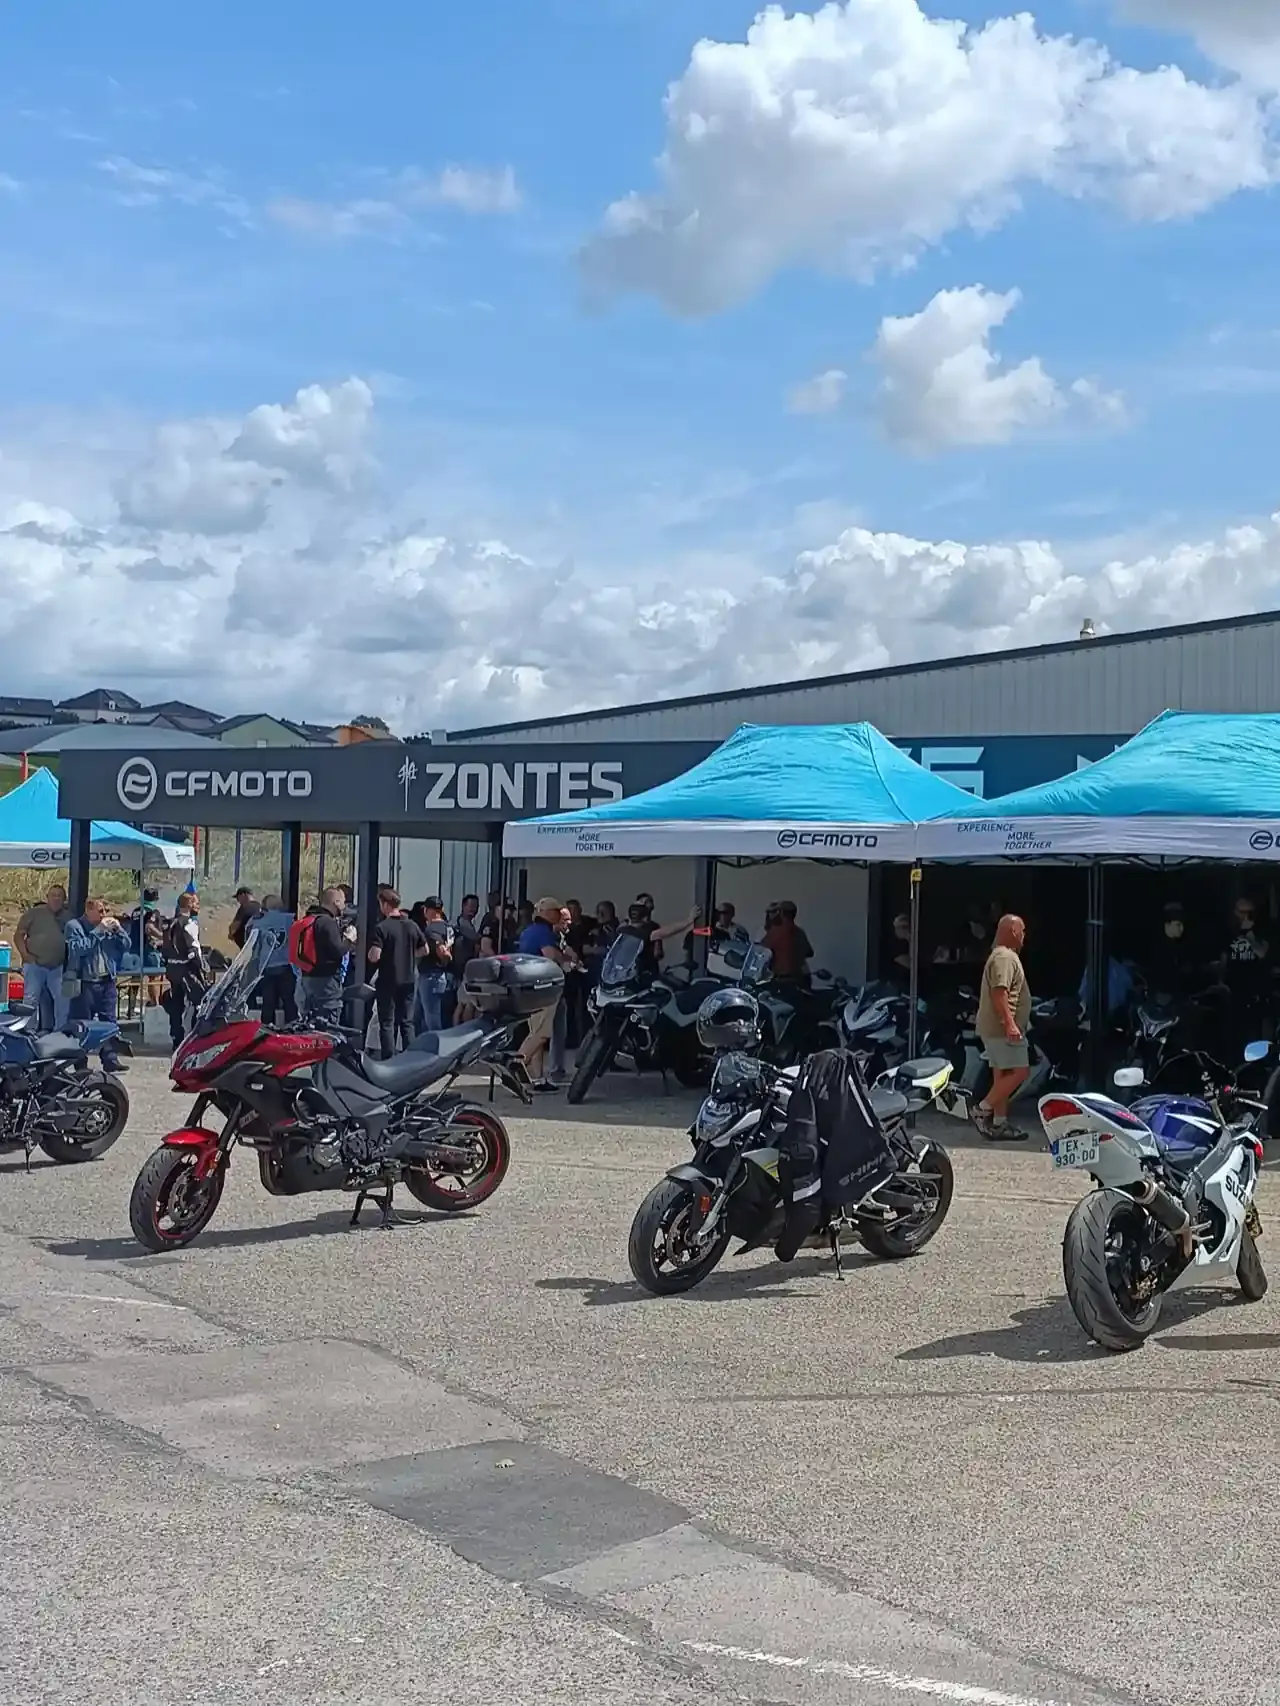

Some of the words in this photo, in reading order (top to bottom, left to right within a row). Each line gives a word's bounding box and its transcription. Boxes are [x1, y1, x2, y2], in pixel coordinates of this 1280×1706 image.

[165, 770, 312, 797] CFMOTO
[425, 762, 624, 809] ZONTES
[957, 822, 1017, 833] EXPERIENCE
[577, 832, 601, 841] MORE
[798, 832, 878, 848] CFMOTO
[1007, 831, 1036, 841] MORE
[575, 842, 615, 852] TOGETHER
[1004, 840, 1052, 851] TOGETHER
[51, 851, 121, 862] CFOTO
